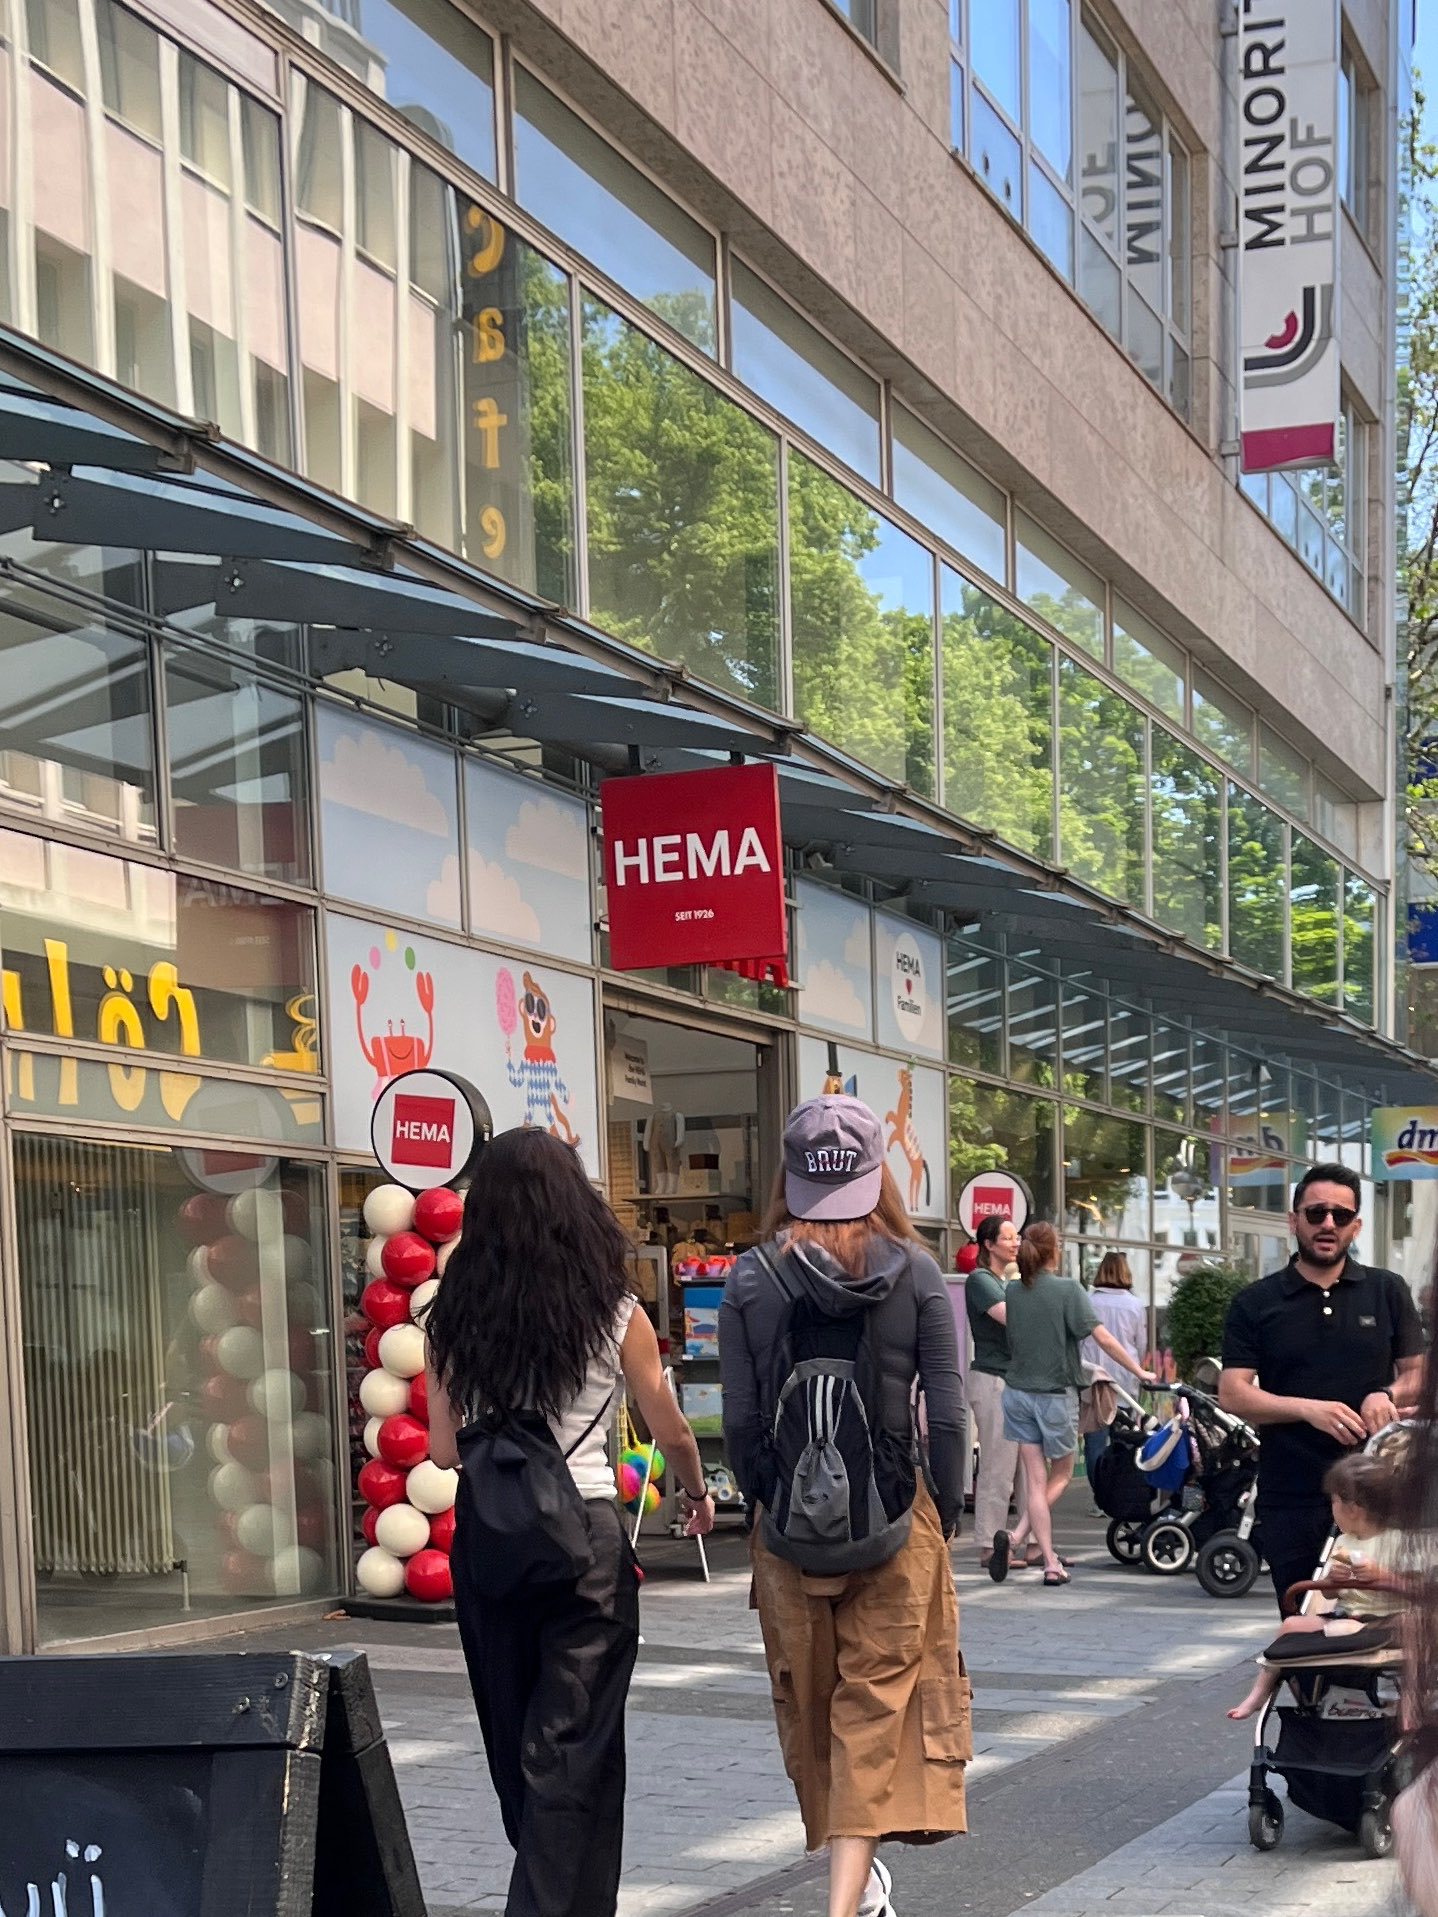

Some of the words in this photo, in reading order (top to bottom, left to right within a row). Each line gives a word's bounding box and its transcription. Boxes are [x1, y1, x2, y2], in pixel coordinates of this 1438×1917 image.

[1290, 116, 1333, 244] HOF
[614, 827, 771, 886] HEMA
[675, 910, 693, 921] SEIT
[693, 909, 715, 920] 1926
[896, 951, 921, 977] HEMA
[395, 1120, 451, 1143] HEMA
[804, 1150, 857, 1172] BRUT
[974, 1202, 1011, 1217] HEMA
